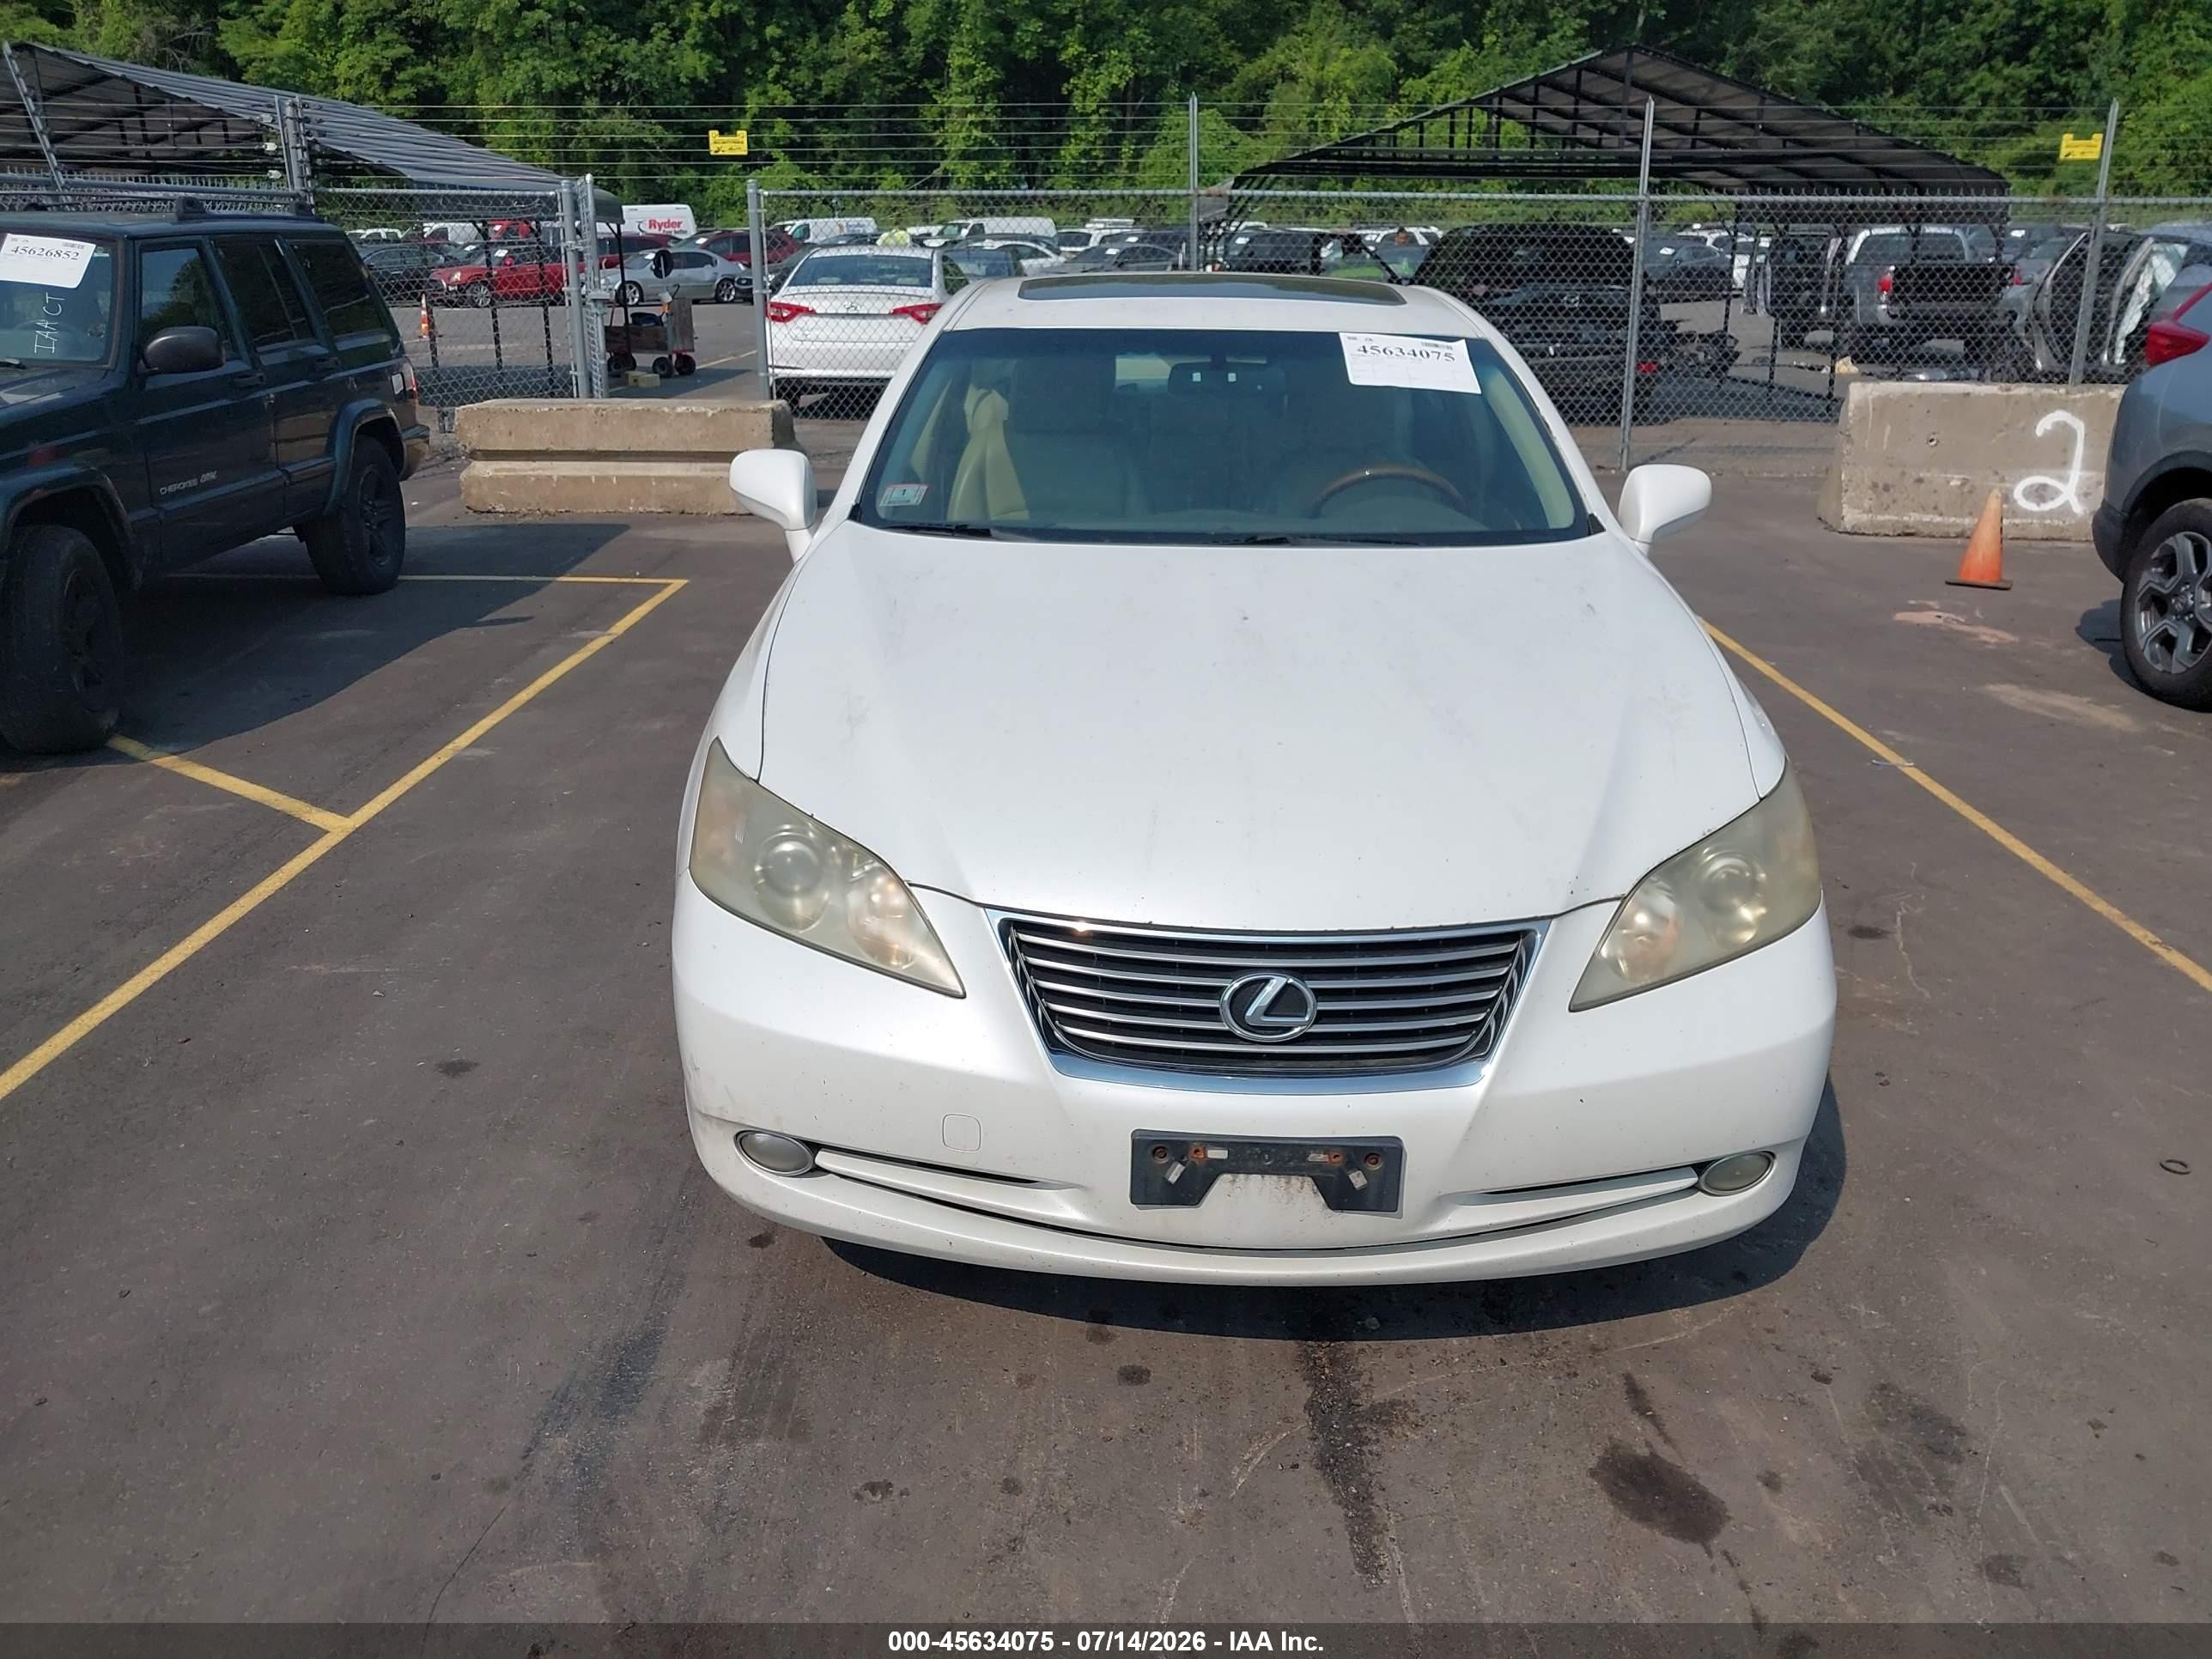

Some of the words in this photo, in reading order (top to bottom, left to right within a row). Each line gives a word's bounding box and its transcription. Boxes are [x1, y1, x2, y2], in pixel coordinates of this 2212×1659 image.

[648, 218, 683, 231] Ryder
[11, 246, 80, 260] 45626852
[43, 291, 65, 315] CT
[34, 320, 58, 354] IAA
[1357, 344, 1455, 362] 45634075
[2014, 410, 2085, 514] 2
